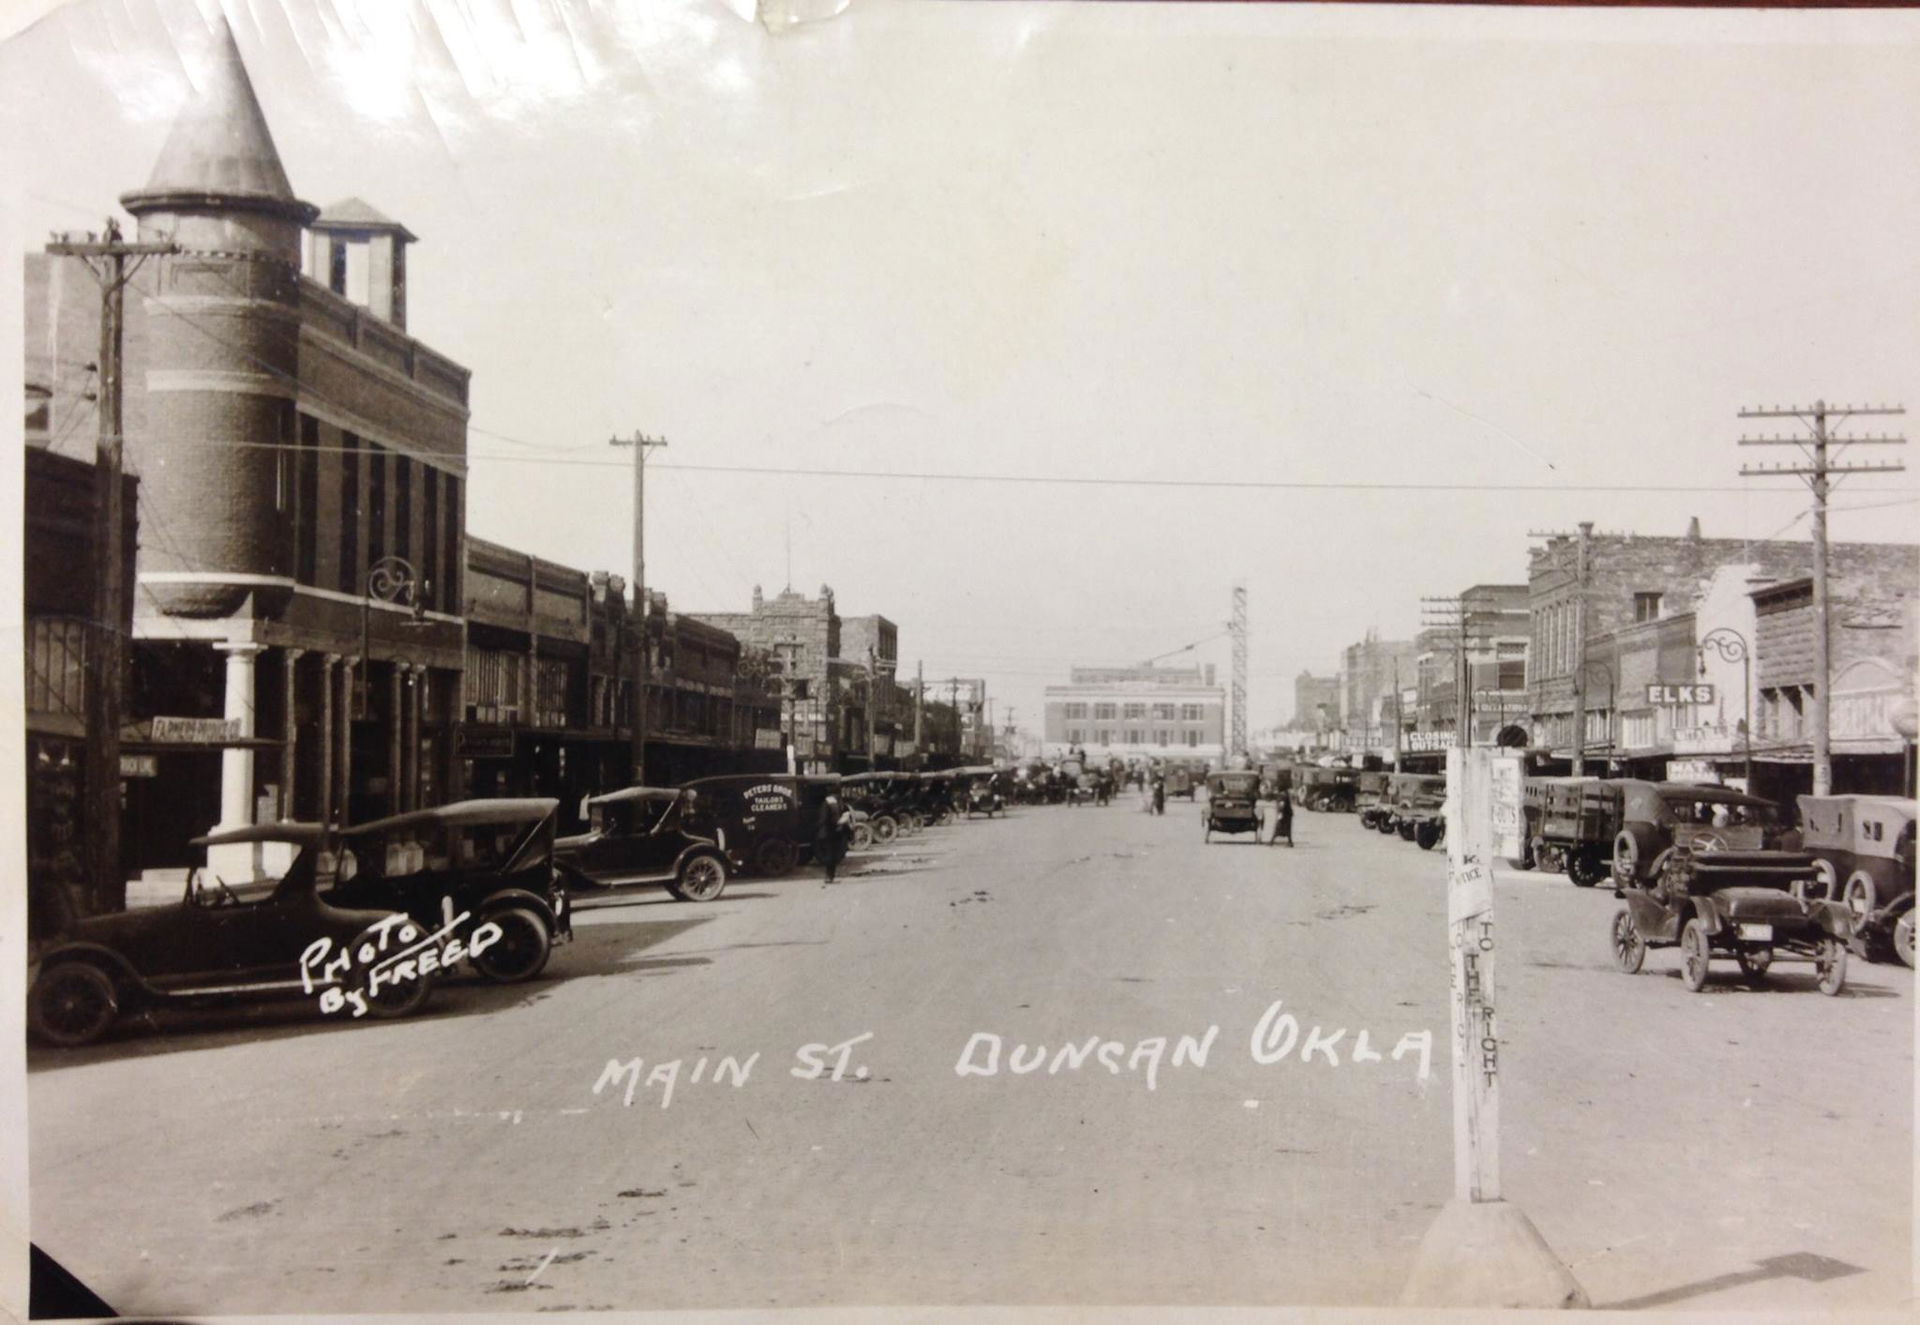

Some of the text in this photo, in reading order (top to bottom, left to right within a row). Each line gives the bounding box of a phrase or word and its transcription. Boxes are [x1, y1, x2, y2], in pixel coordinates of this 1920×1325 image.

[1649, 686, 1711, 703] ELKS
[1410, 731, 1457, 741] CLOSING
[751, 803, 787, 812] CLEANERS
[1482, 1006, 1497, 1088] RIGHT
